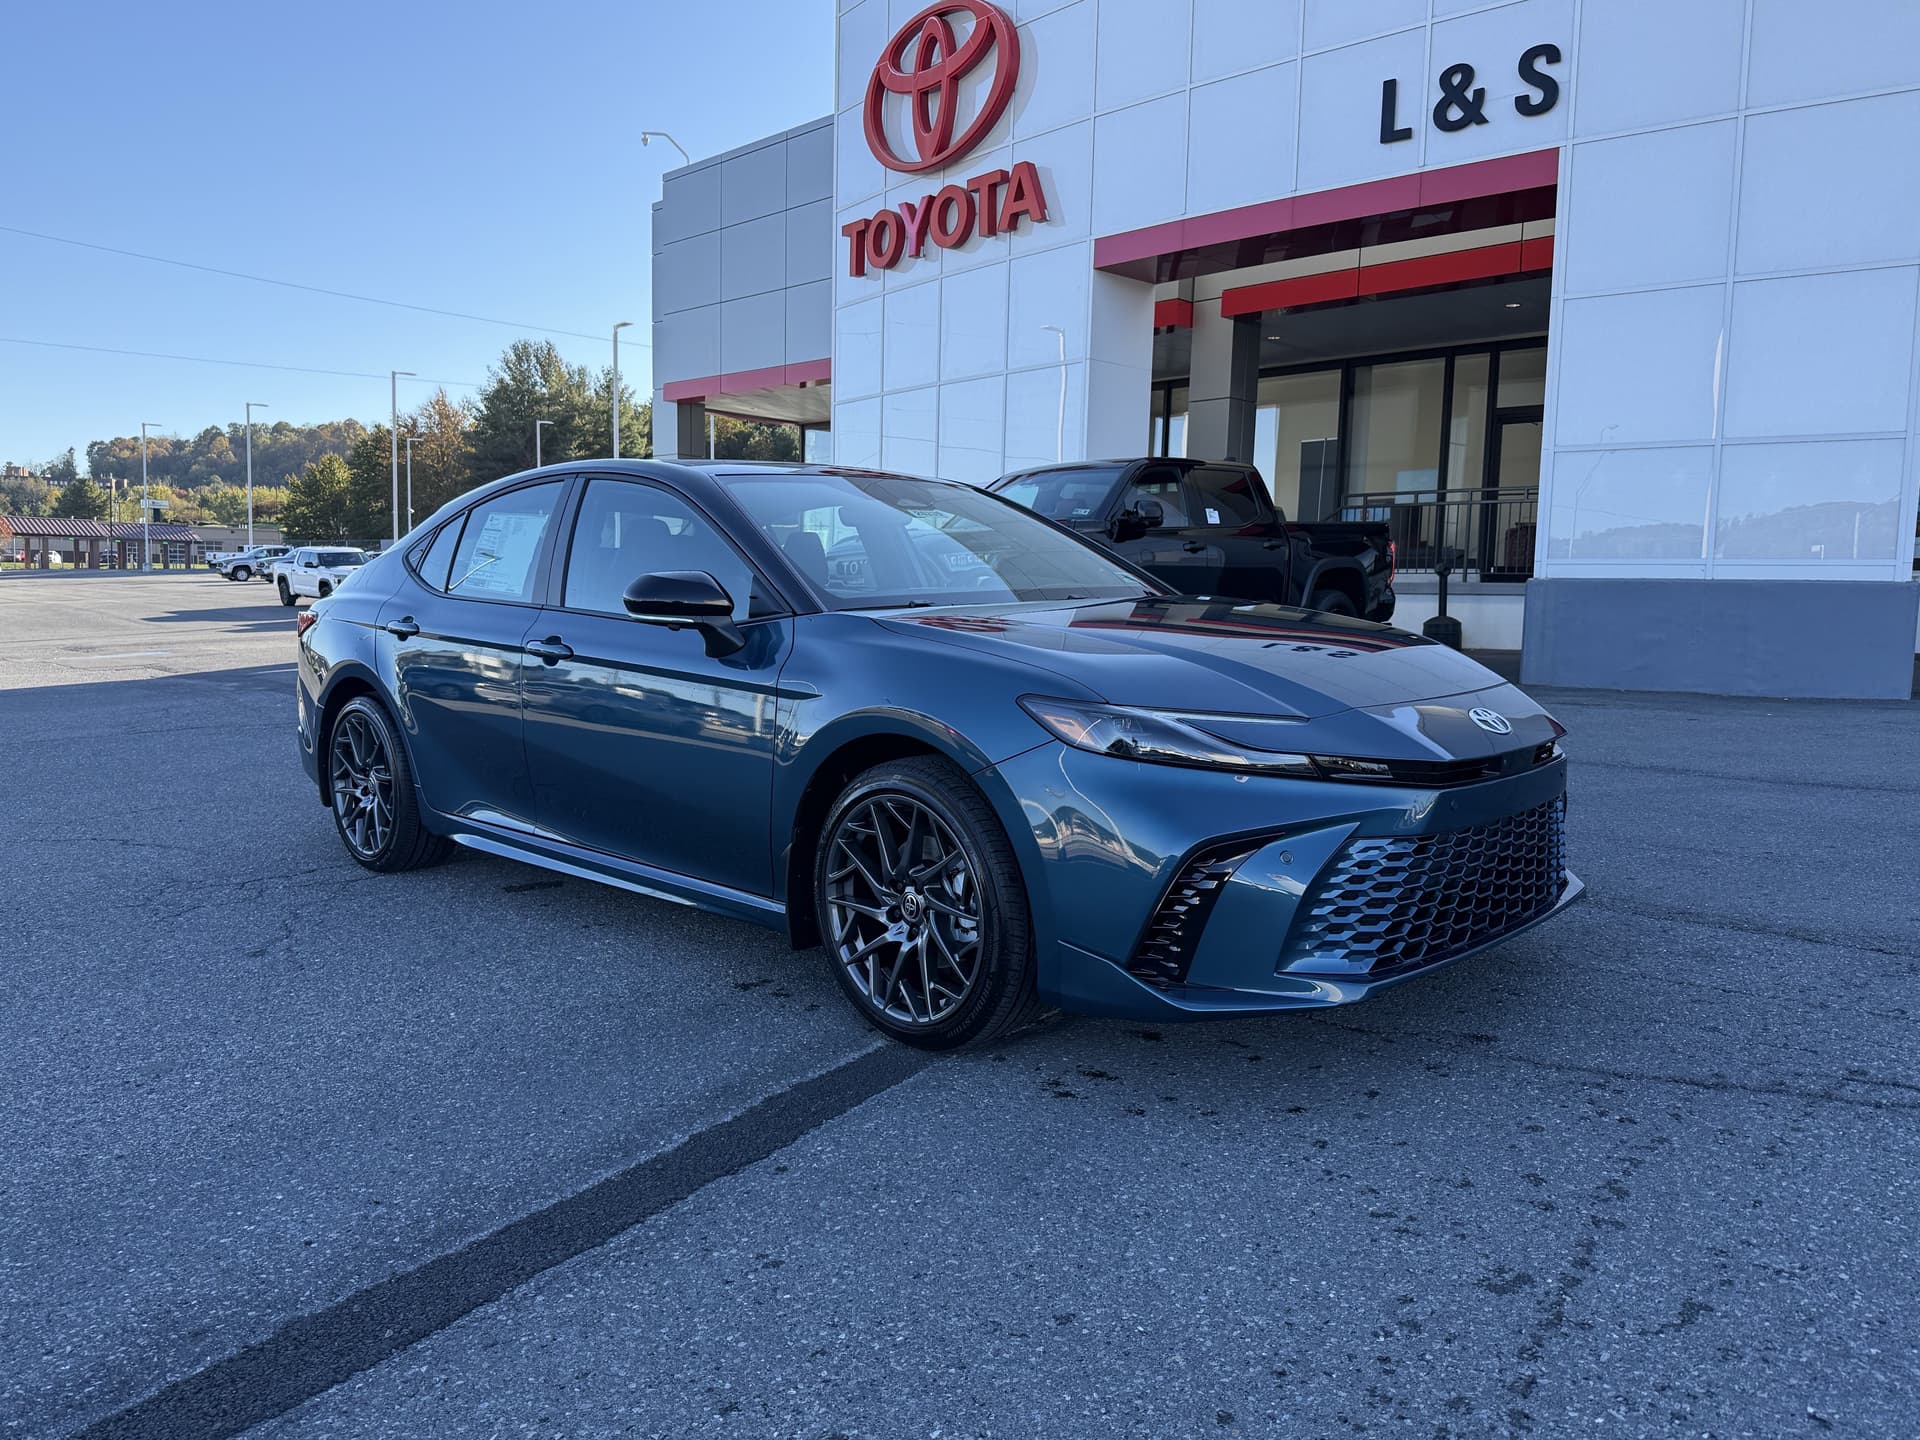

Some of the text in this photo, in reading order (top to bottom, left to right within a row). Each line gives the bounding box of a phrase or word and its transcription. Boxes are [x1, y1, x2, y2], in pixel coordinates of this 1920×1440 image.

[1380, 43, 1562, 144] L & S
[842, 161, 1048, 277] TOYOTA
